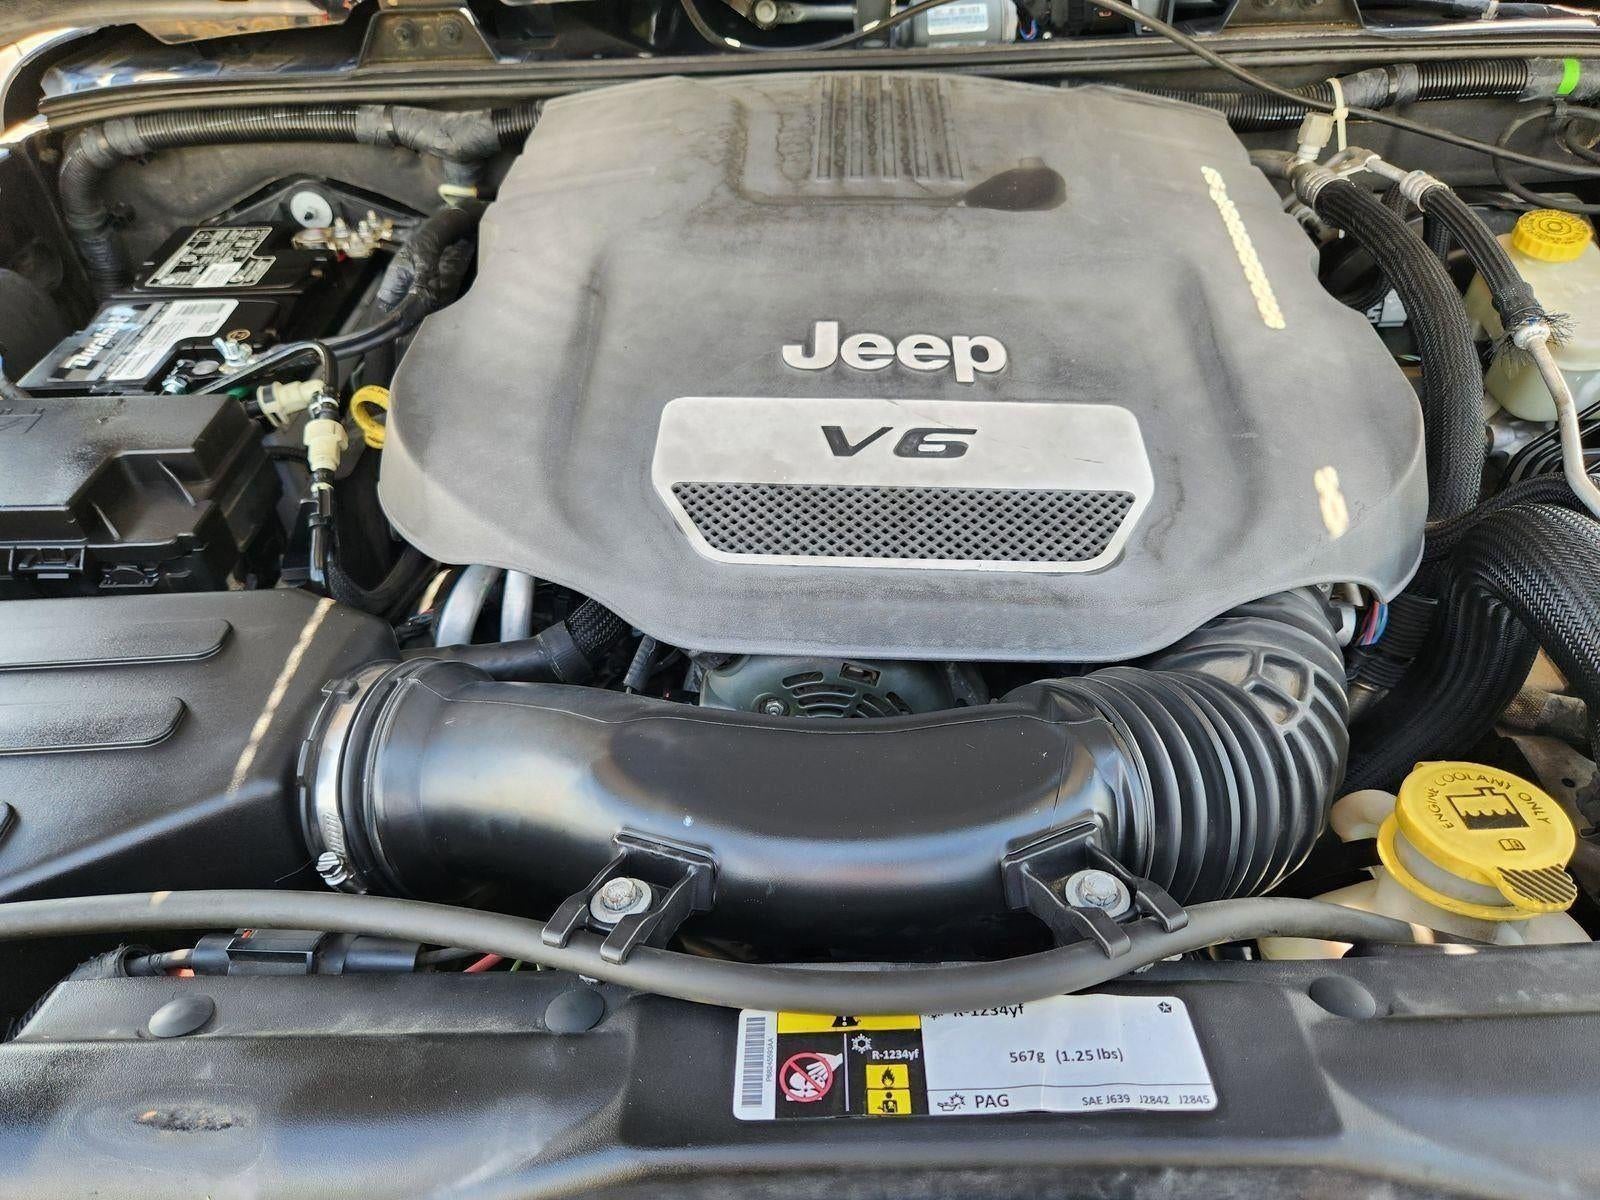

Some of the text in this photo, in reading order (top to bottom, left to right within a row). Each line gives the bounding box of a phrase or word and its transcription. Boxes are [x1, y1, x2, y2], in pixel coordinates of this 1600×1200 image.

[782, 321, 1008, 382] Jeep
[821, 426, 978, 458] V6
[1424, 772, 1551, 829] ENGINE COOLANT ONLY
[871, 1049, 920, 1062] R-1234yf
[1009, 1048, 1124, 1064] 567g (1.25 lbs)
[975, 1094, 1010, 1108] PAG
[1082, 1095, 1210, 1106] SAE J639 J2842 J2845
